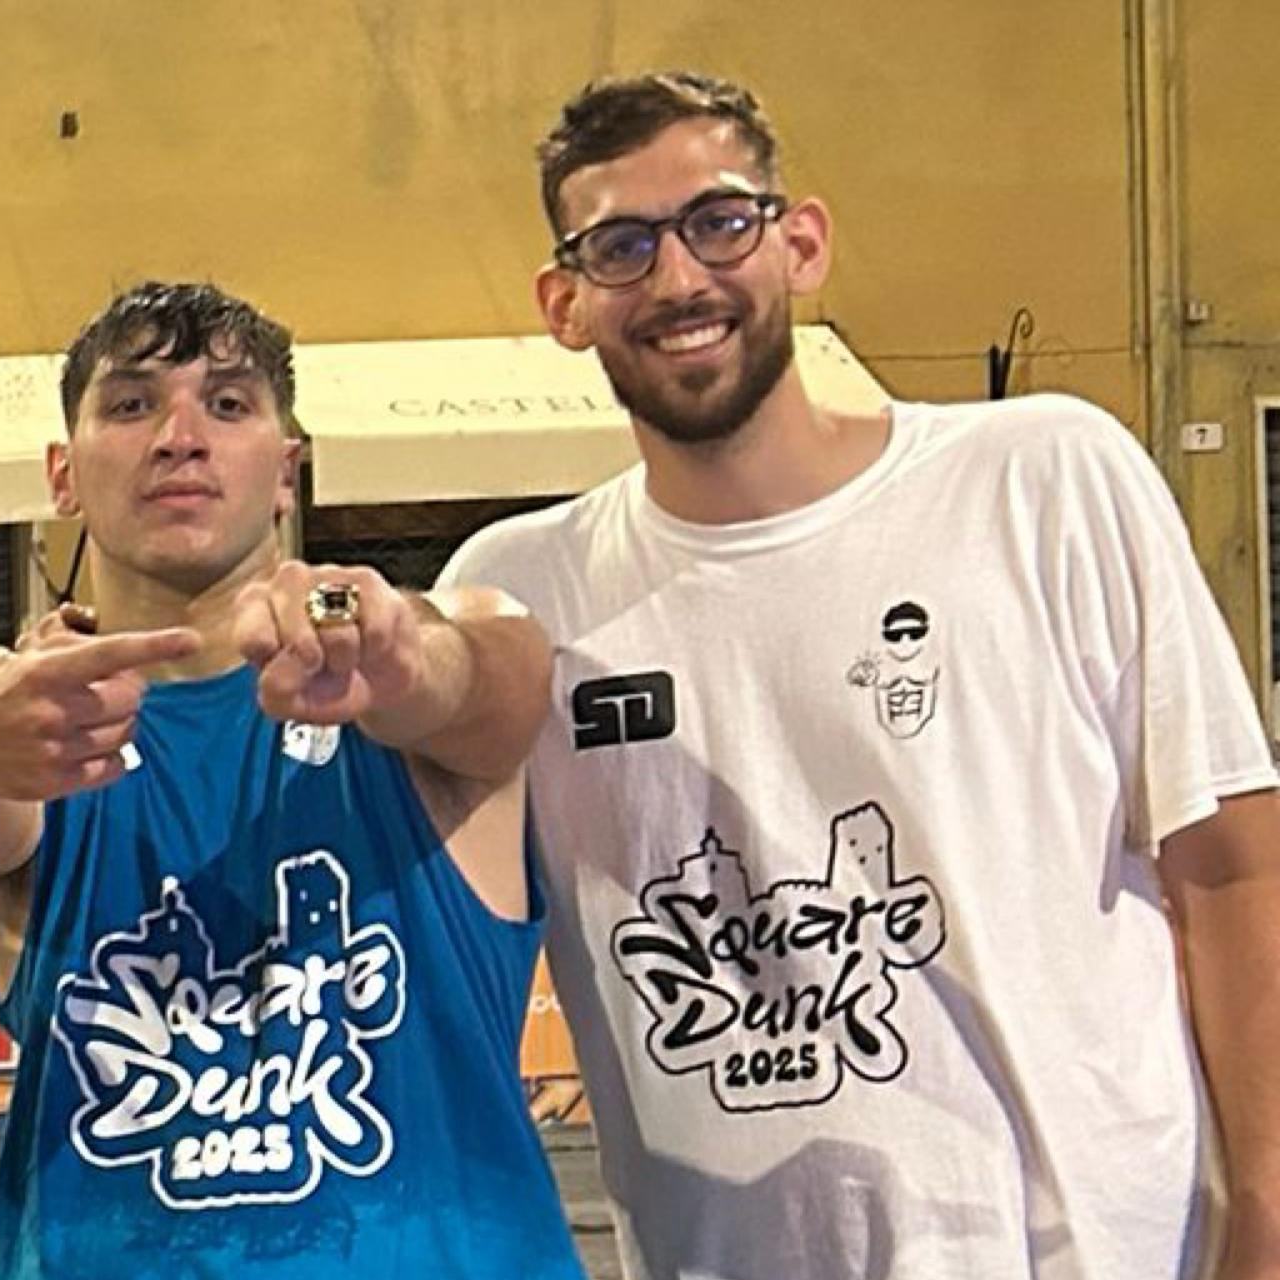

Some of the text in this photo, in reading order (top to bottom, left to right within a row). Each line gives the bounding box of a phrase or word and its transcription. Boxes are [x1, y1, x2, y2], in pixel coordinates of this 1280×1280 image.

[388, 395, 614, 417] CASTEL
[1195, 427, 1208, 445] 7
[620, 893, 929, 978] Square
[65, 944, 389, 1053] Square
[646, 951, 880, 1056] Dunk
[87, 1020, 362, 1145] Dunk
[725, 1043, 818, 1087] 2025
[172, 1125, 293, 1181] 2025
